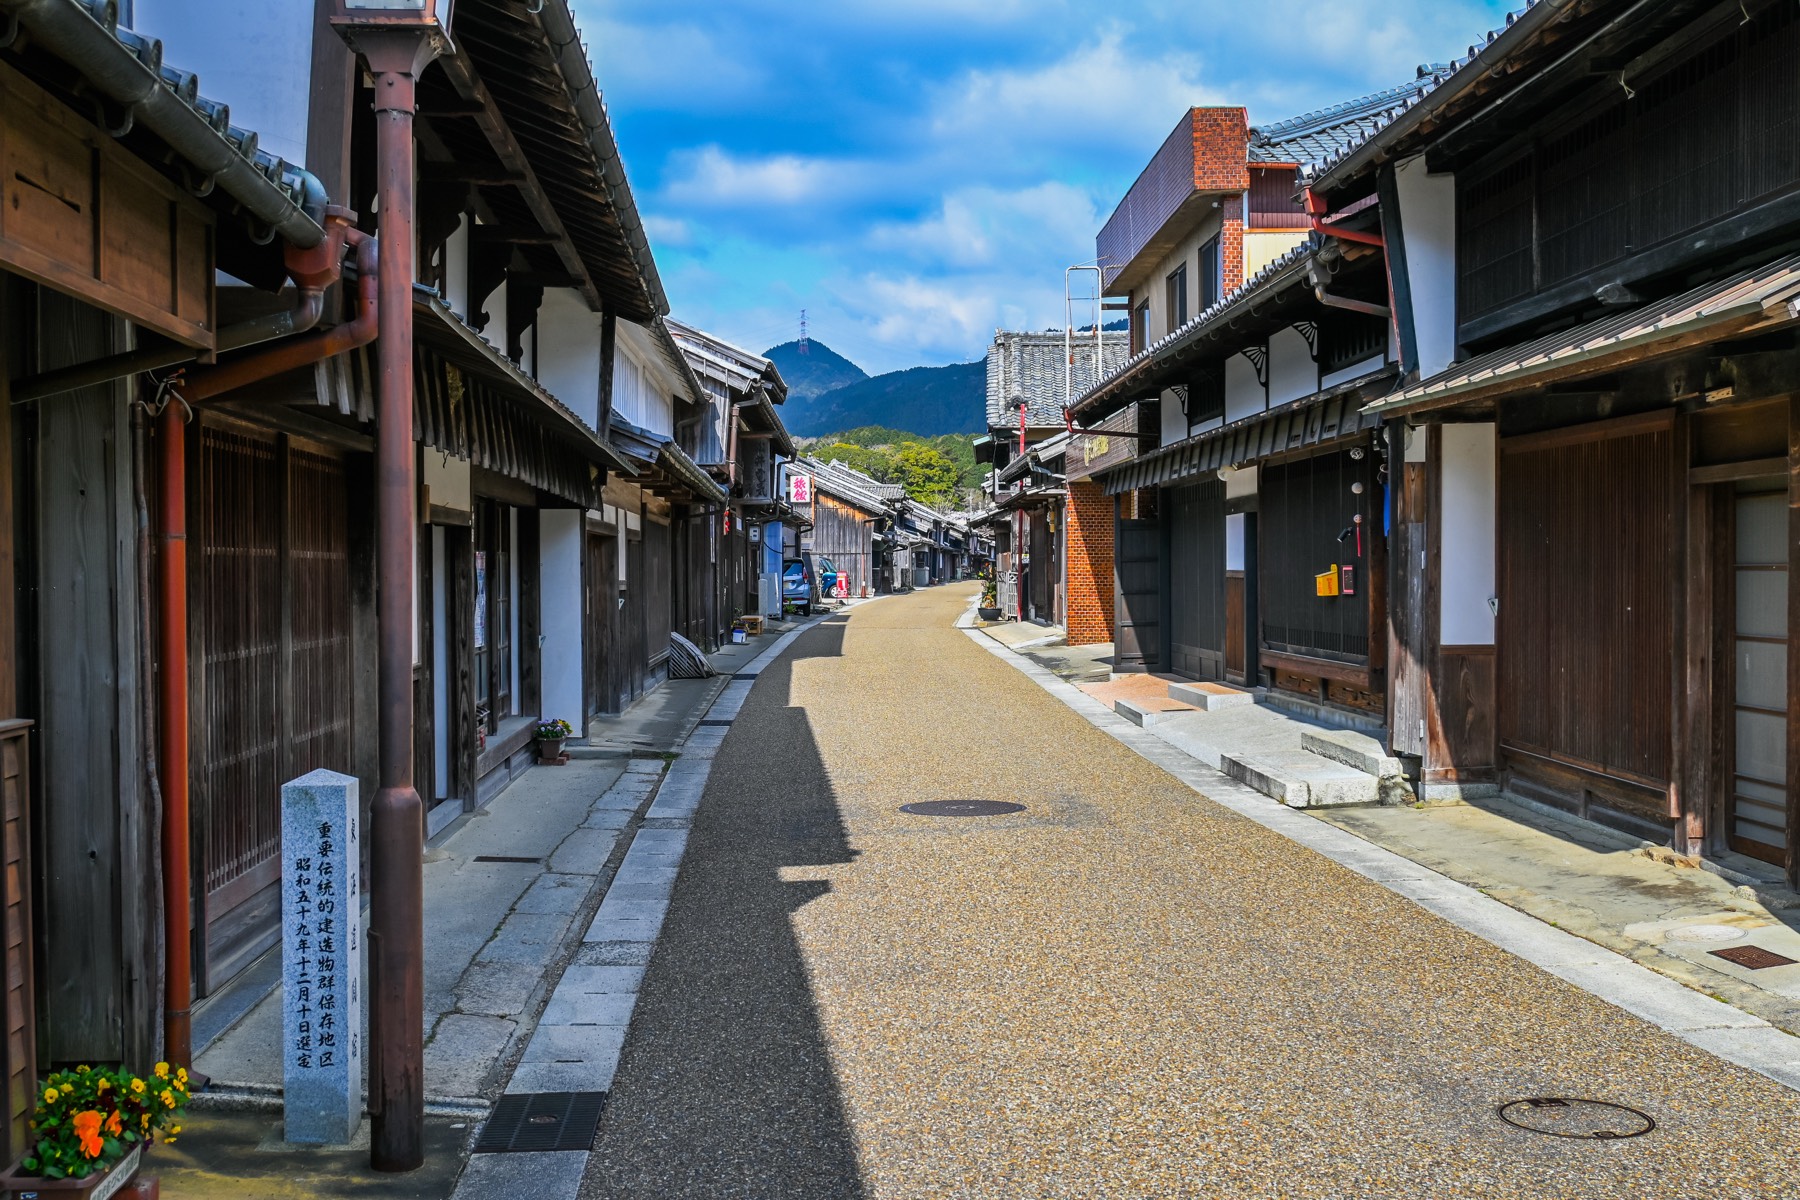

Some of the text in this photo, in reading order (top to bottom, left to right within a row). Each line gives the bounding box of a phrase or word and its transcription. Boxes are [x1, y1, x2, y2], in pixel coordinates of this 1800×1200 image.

[793, 477, 807, 502] 旅館
[295, 857, 312, 1068] 昭和五十九年十二月十日選定
[316, 822, 335, 1067] 重要伝統的建造物群保存地区
